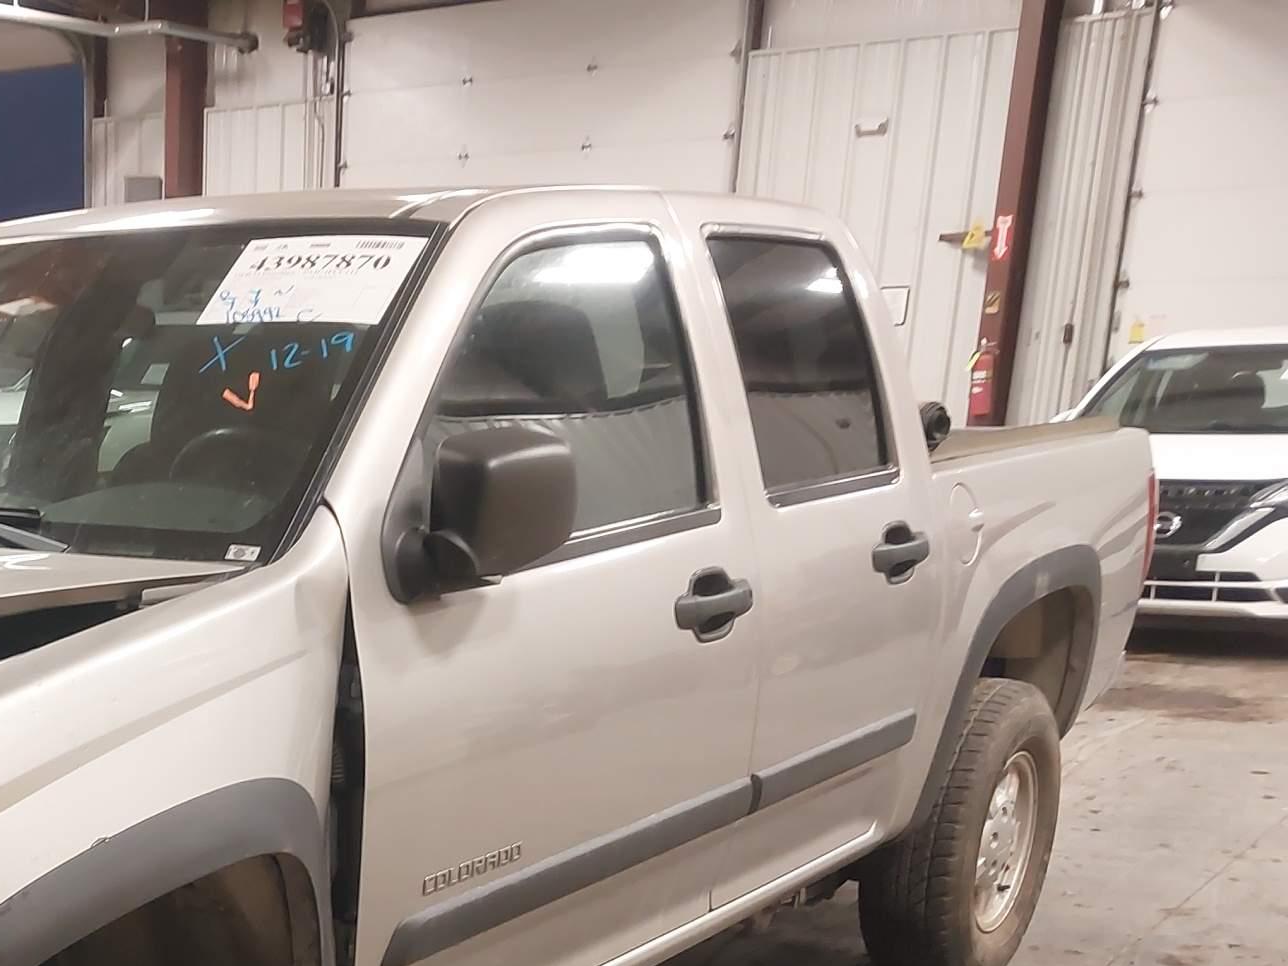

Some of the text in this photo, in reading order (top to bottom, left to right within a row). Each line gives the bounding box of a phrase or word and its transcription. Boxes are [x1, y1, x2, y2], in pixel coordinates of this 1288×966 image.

[249, 254, 392, 272] 43987870
[269, 331, 355, 372] 12-19
[422, 841, 523, 896] COLORADO
